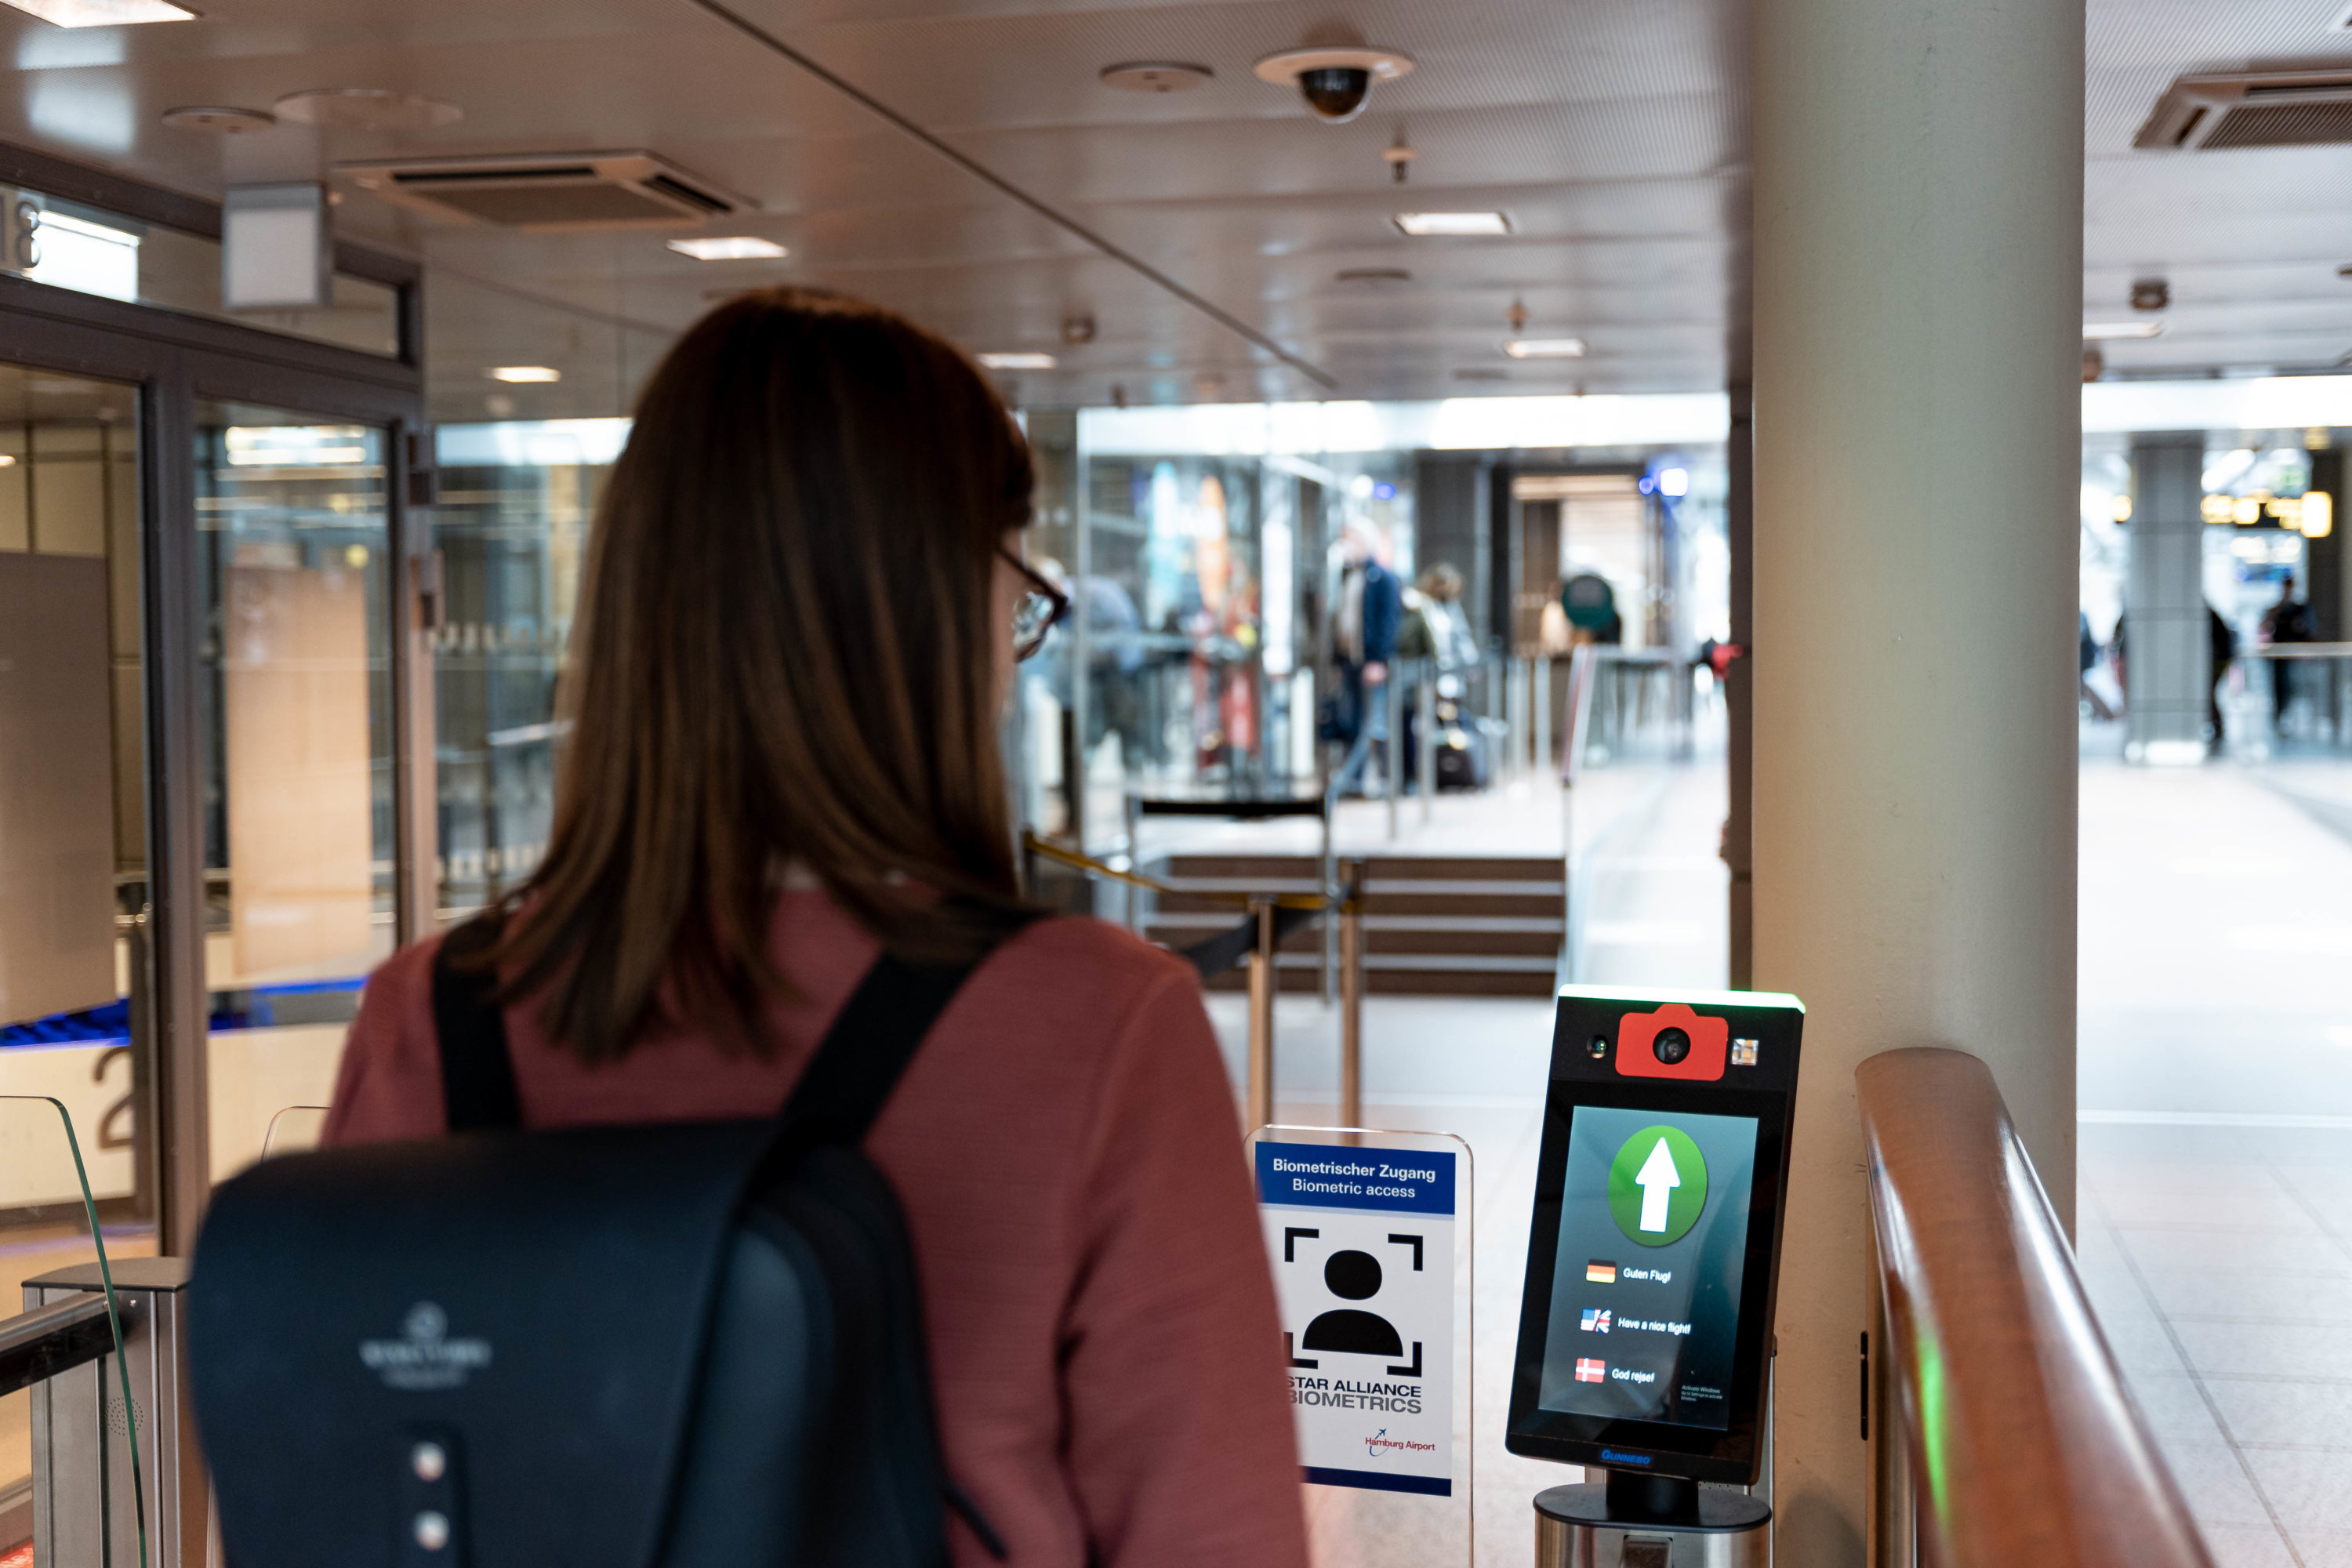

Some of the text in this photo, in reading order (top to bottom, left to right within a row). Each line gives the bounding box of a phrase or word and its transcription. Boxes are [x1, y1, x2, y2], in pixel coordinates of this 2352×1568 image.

[1273, 1158, 1436, 1183] Biometrischer Zugang
[1293, 1178, 1416, 1198] Biometric access
[1623, 1267, 1671, 1283] Guten Flug!
[1617, 1317, 1639, 1329] Have
[1649, 1321, 1666, 1332] nice
[1668, 1323, 1691, 1335] flight!
[1611, 1368, 1655, 1384] God rejse!
[1334, 1380, 1421, 1398] ALLIANCE
[1365, 1437, 1436, 1451] Hamburg Airport
[1602, 1450, 1650, 1465] GUNNEBO
